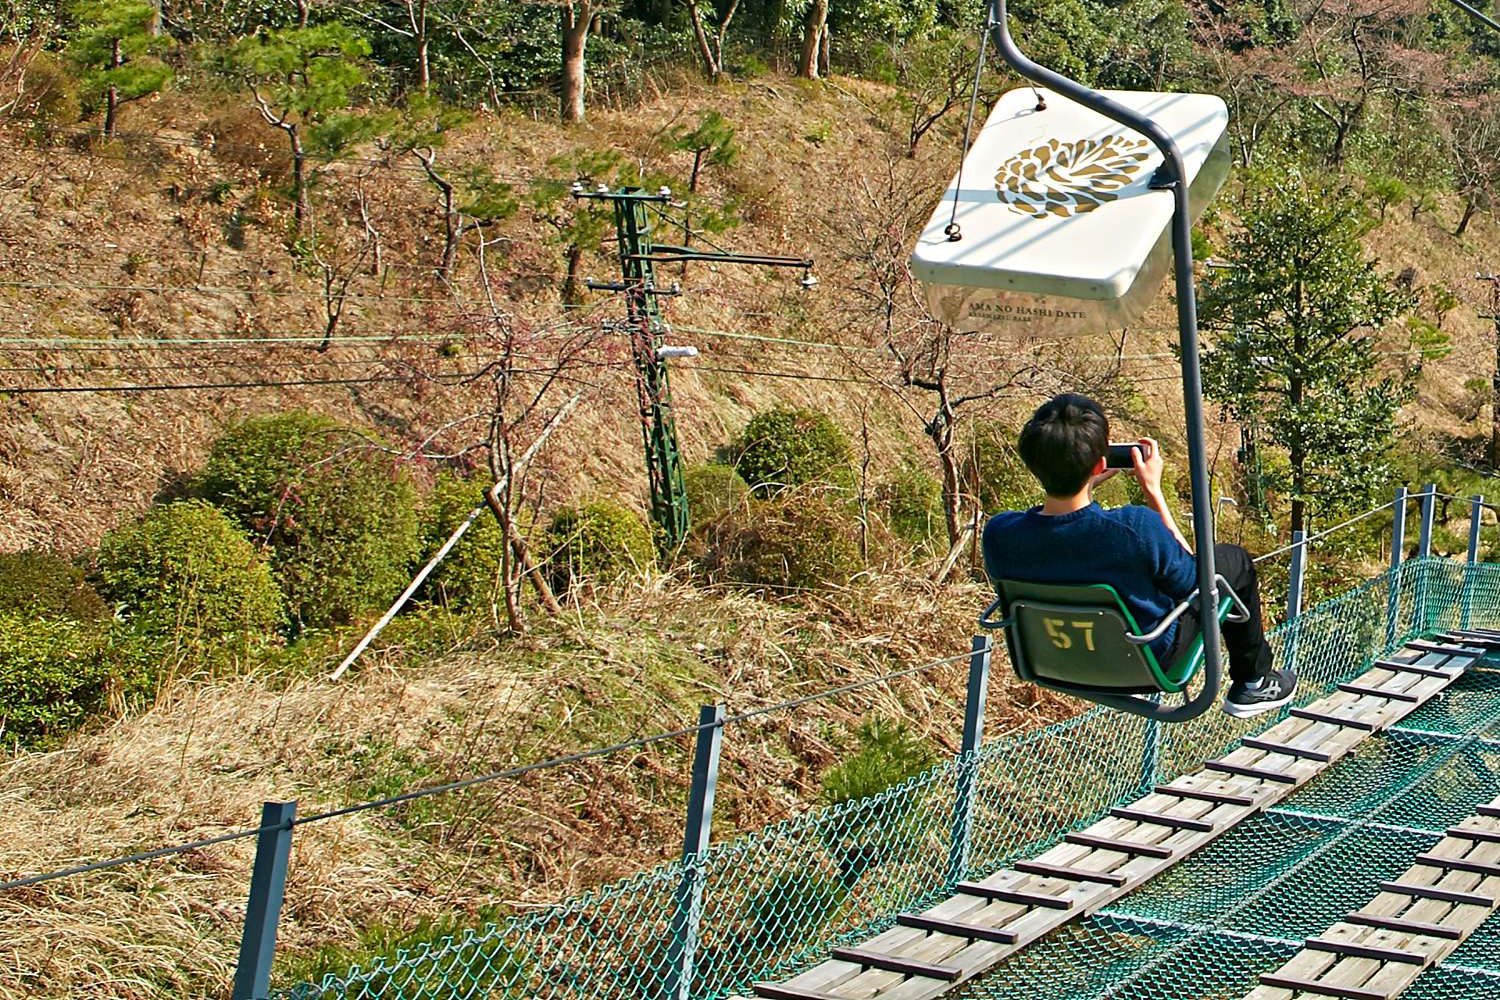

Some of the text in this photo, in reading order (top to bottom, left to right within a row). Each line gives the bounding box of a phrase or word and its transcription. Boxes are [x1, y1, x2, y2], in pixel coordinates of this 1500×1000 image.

[968, 302, 1086, 319] AMA NO HASHI DATE
[1043, 617, 1095, 651] 57
